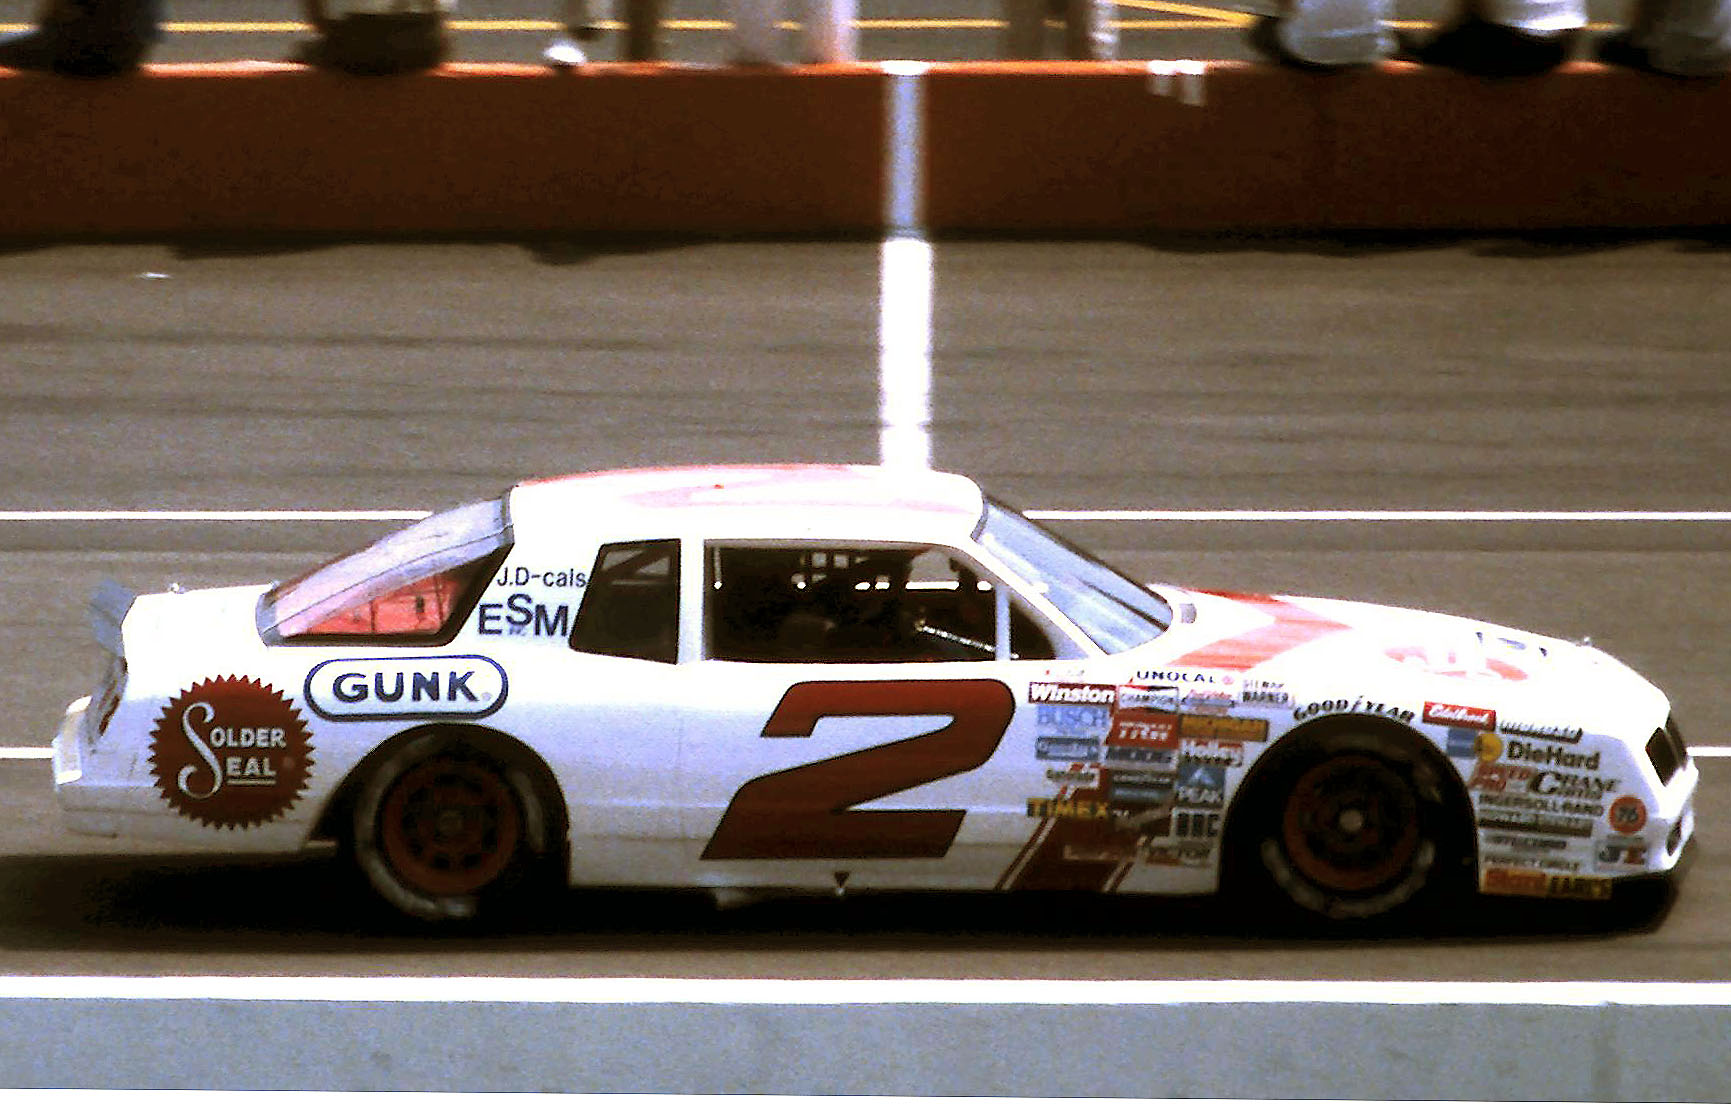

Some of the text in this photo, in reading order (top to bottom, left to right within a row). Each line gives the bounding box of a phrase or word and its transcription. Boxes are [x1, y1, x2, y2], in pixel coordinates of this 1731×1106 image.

[497, 566, 587, 588] J.D-cals
[479, 593, 568, 636] ESM
[333, 670, 479, 702] GUNK
[1136, 670, 1216, 684] UNOCAL
[1030, 683, 1116, 704] Winston
[1507, 740, 1600, 770] DieHard
[700, 679, 1016, 860] 2
[1029, 798, 1109, 818] TIMEX
